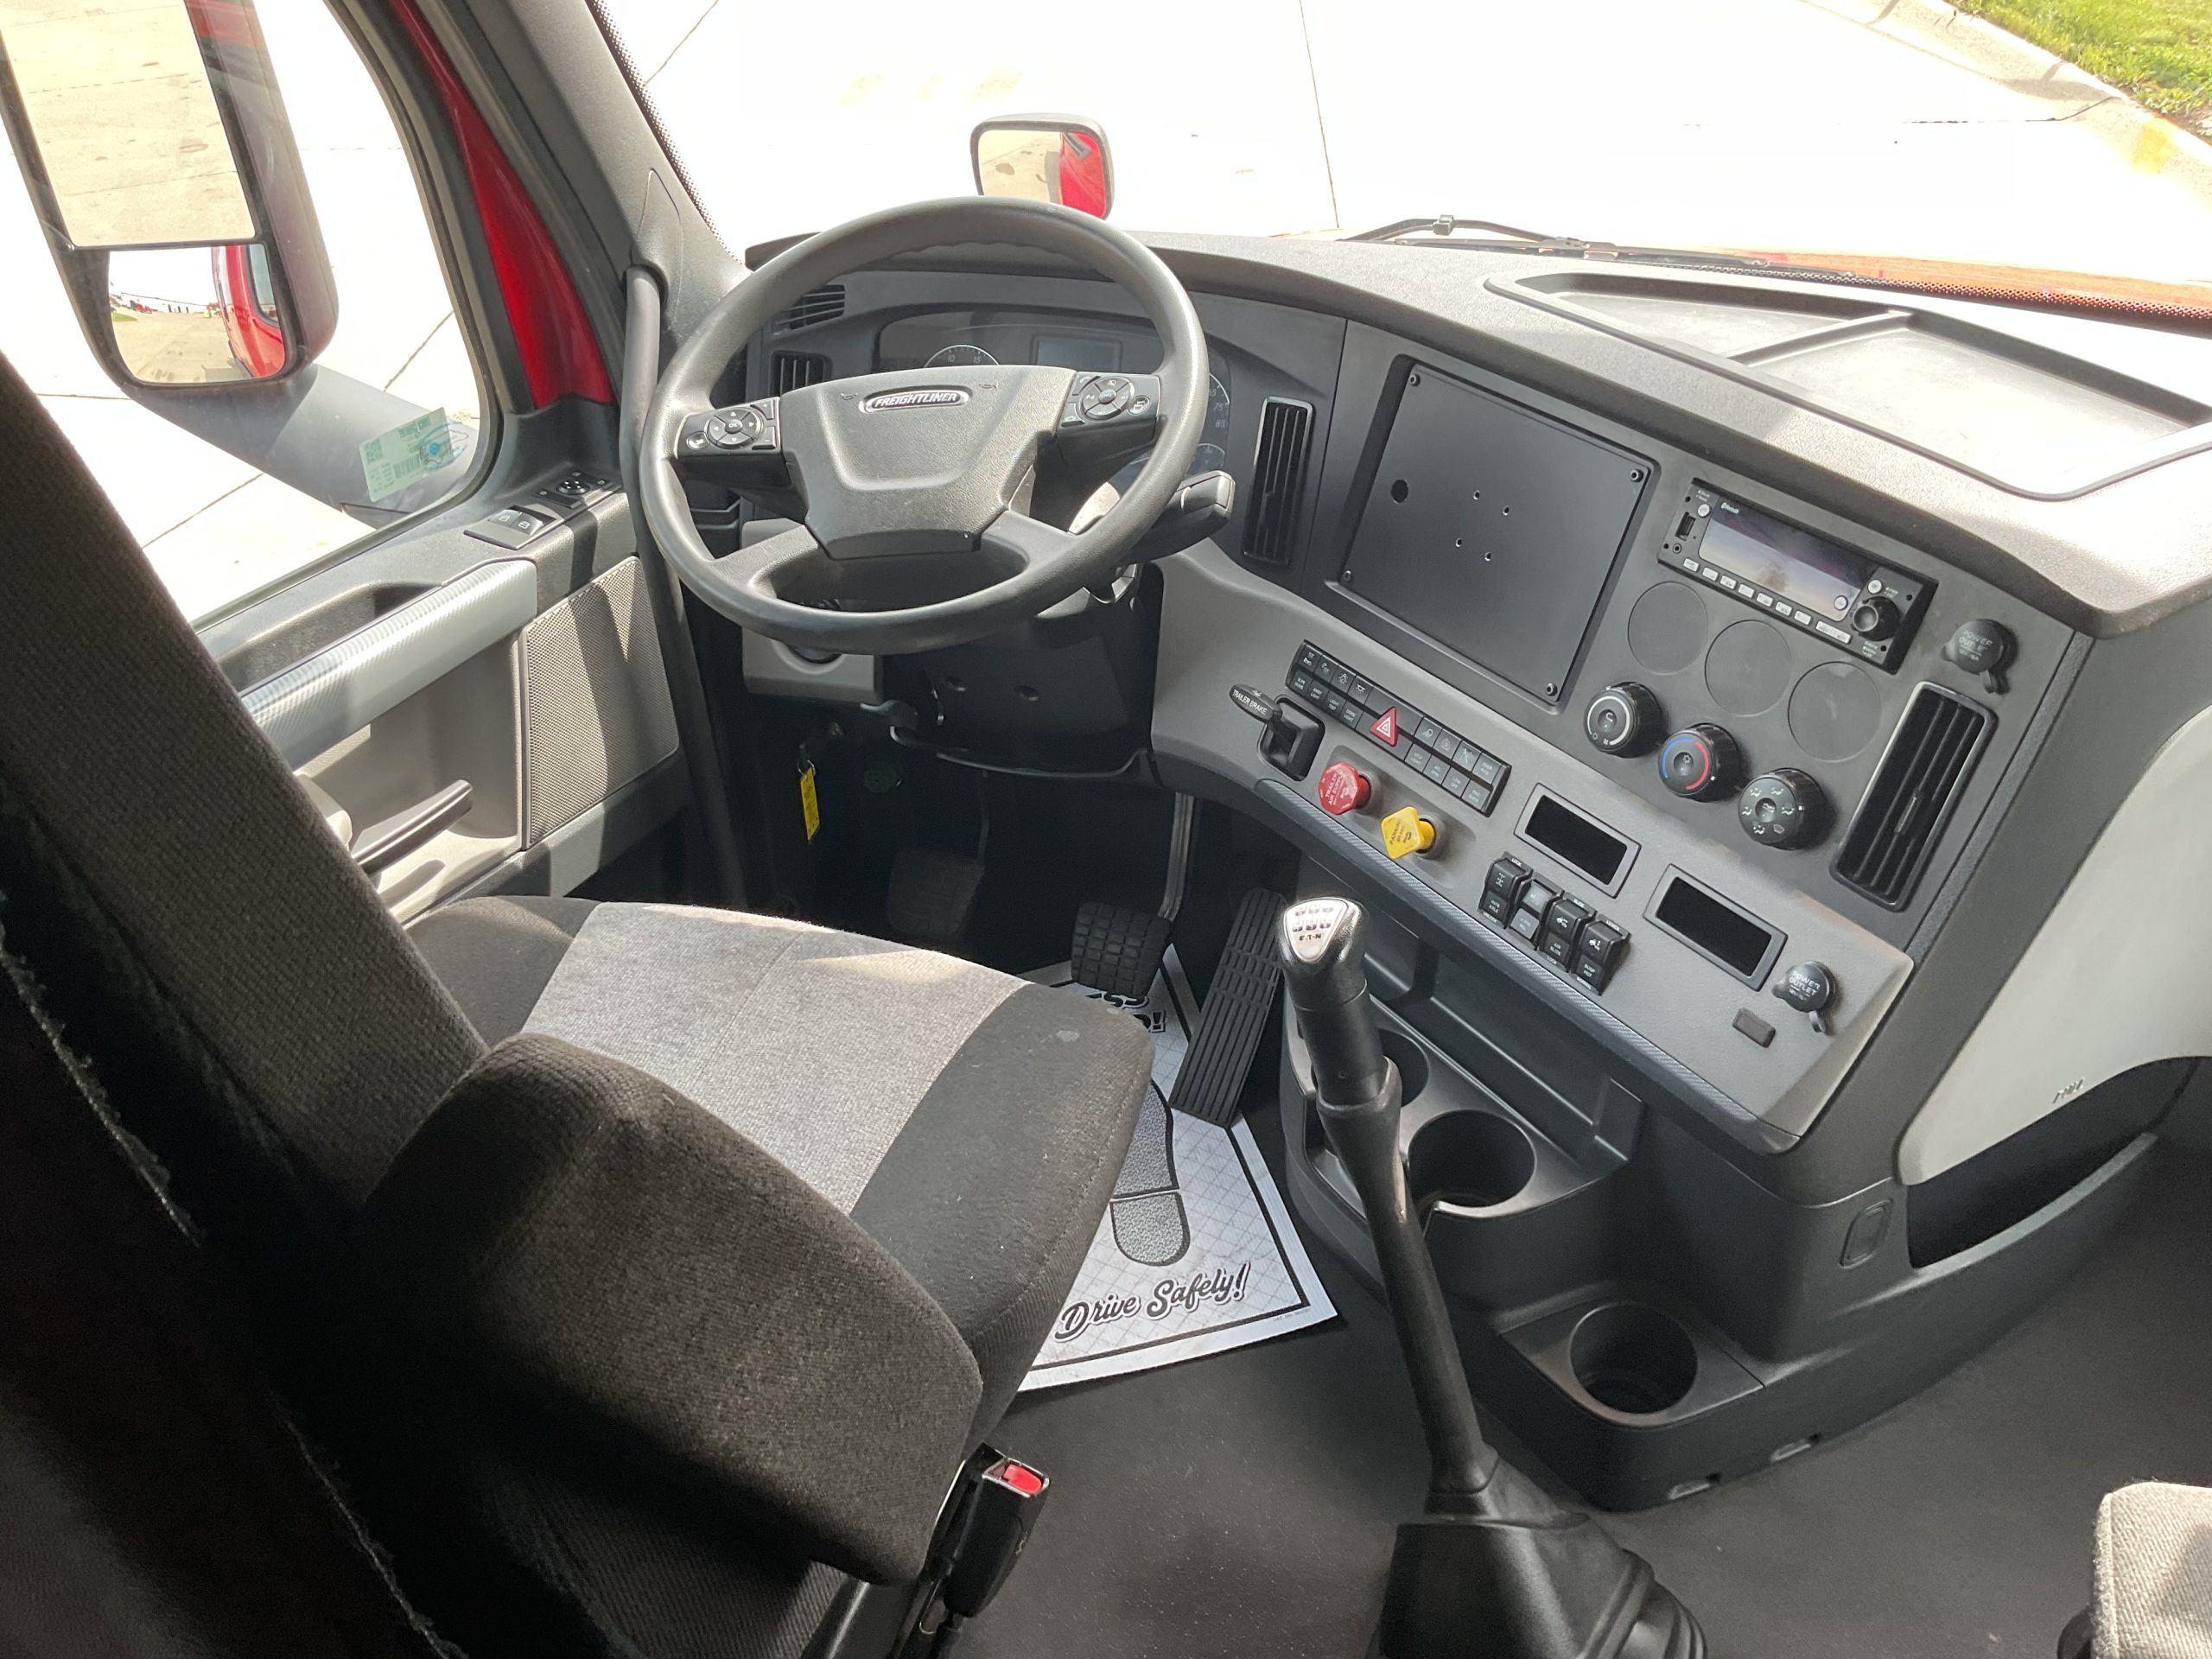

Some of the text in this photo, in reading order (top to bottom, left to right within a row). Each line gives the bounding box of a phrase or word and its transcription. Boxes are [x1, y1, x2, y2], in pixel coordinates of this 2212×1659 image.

[874, 391, 957, 408] FREIGHTLINER
[1213, 403, 1224, 411] 75
[1232, 689, 1268, 715] TRAILER BRAKE
[1325, 772, 1338, 798] TRAILER
[1511, 857, 1522, 867] LOCK
[1789, 977, 1817, 995] OUTLET
[1054, 1262, 1251, 1340] Drive Safely!
